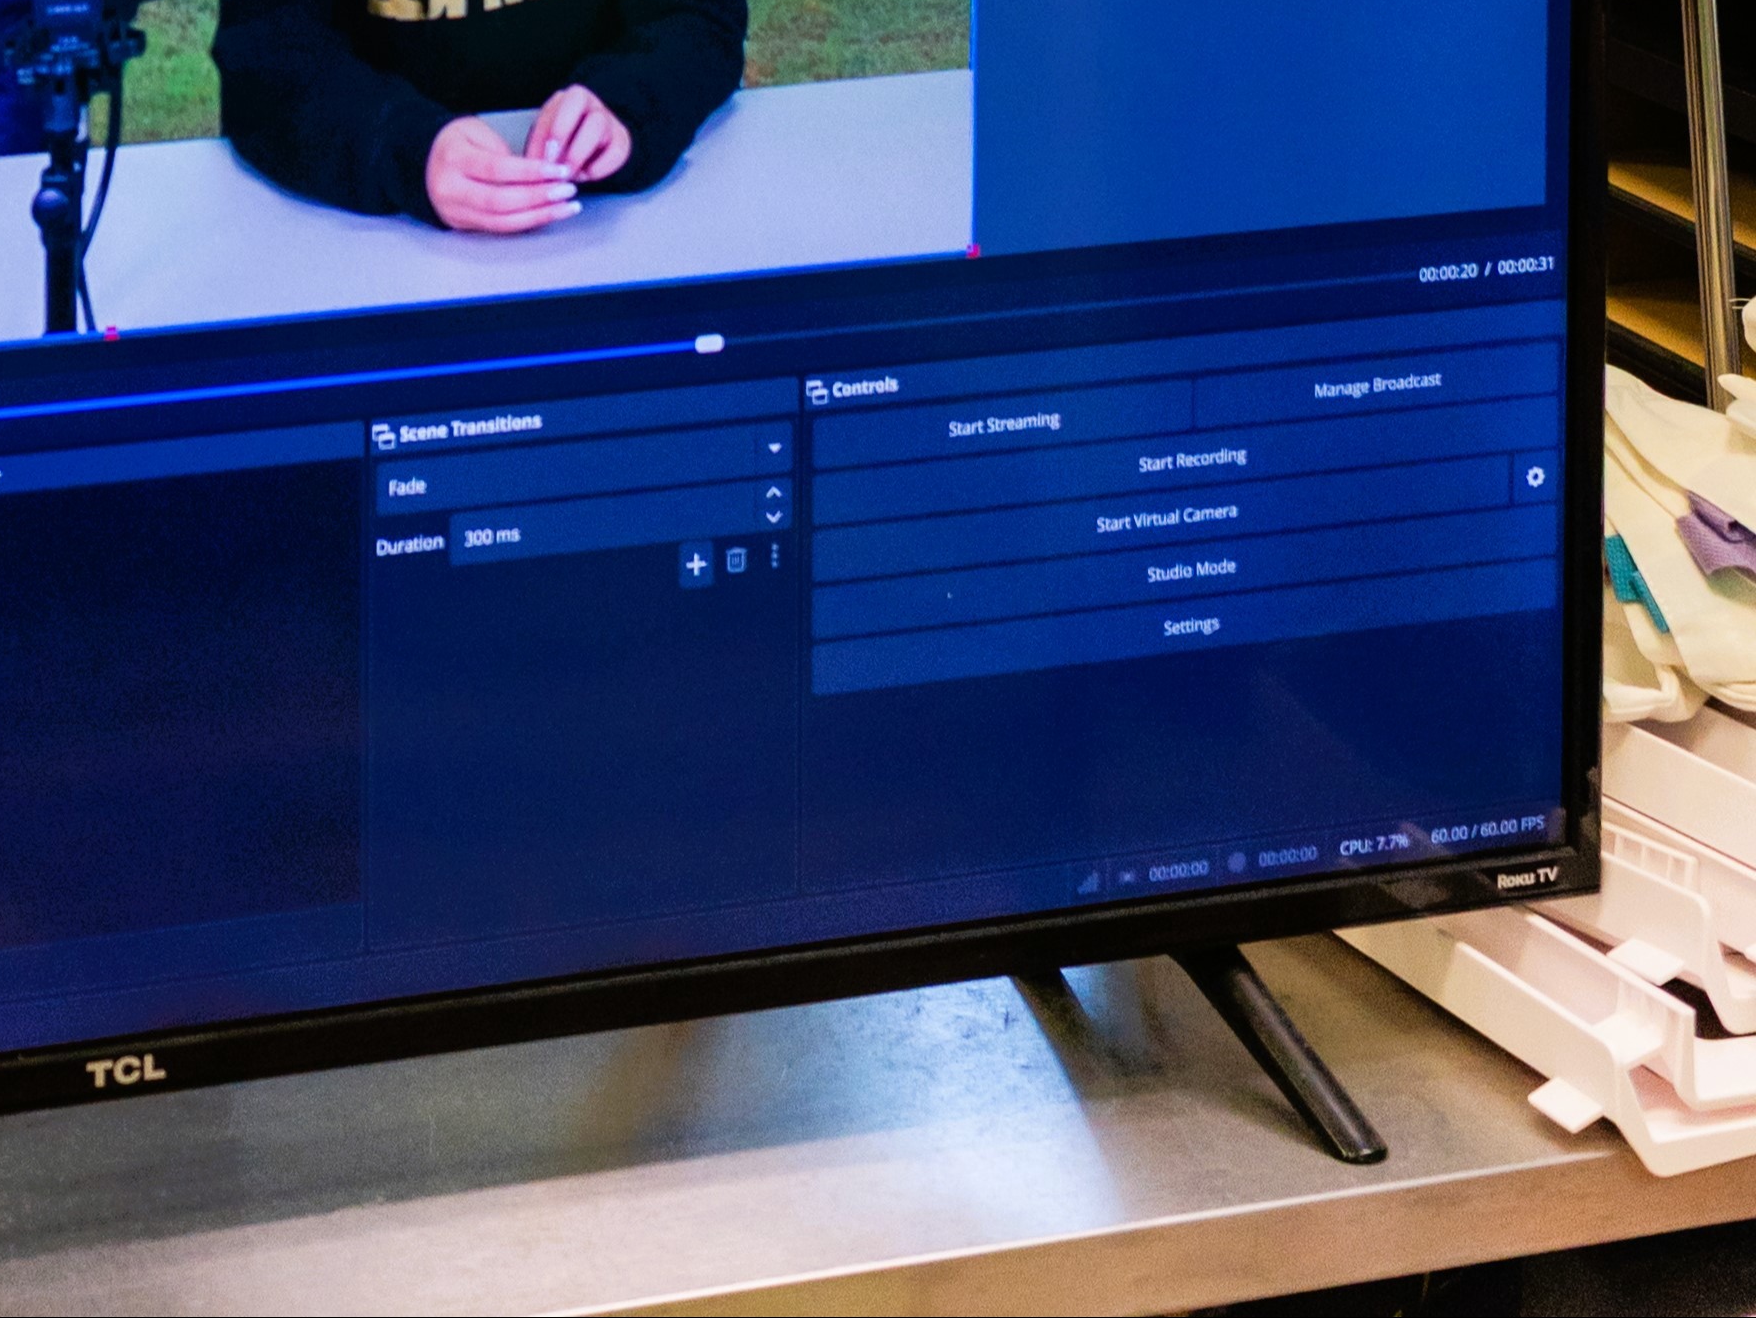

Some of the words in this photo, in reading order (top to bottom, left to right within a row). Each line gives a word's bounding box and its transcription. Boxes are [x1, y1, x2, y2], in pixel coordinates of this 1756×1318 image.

[1419, 262, 1479, 283] 00:00:20
[1498, 256, 1555, 275] 00:00:31
[832, 376, 899, 398] Controls
[1314, 381, 1370, 399] Manage
[1373, 373, 1442, 393] Broadcast
[400, 424, 448, 443] Scene
[451, 414, 543, 437] Transitions
[949, 420, 984, 438] Start
[987, 412, 1061, 433] Streaming
[1139, 456, 1174, 473] Start
[1176, 448, 1248, 468] Recording
[389, 477, 427, 497] Fade
[1096, 516, 1132, 533] Start
[1133, 509, 1179, 528] Virtual
[1183, 505, 1238, 523] Camera
[376, 534, 445, 556] Duration
[464, 528, 494, 548] 300
[496, 528, 521, 544] ms
[1147, 563, 1193, 583] Studio
[1196, 558, 1236, 576] Mode
[1164, 617, 1220, 636] Settings
[1431, 825, 1468, 844] 60.00
[1480, 819, 1517, 837] 60.00
[1521, 815, 1545, 831] FPS
[1258, 845, 1318, 867] 00:00:00
[1340, 838, 1372, 856] CPU:
[1376, 833, 1410, 850] 7.7%
[1148, 860, 1209, 882] 00:00:00
[1537, 866, 1559, 882] TV
[86, 1055, 167, 1088] TCL
